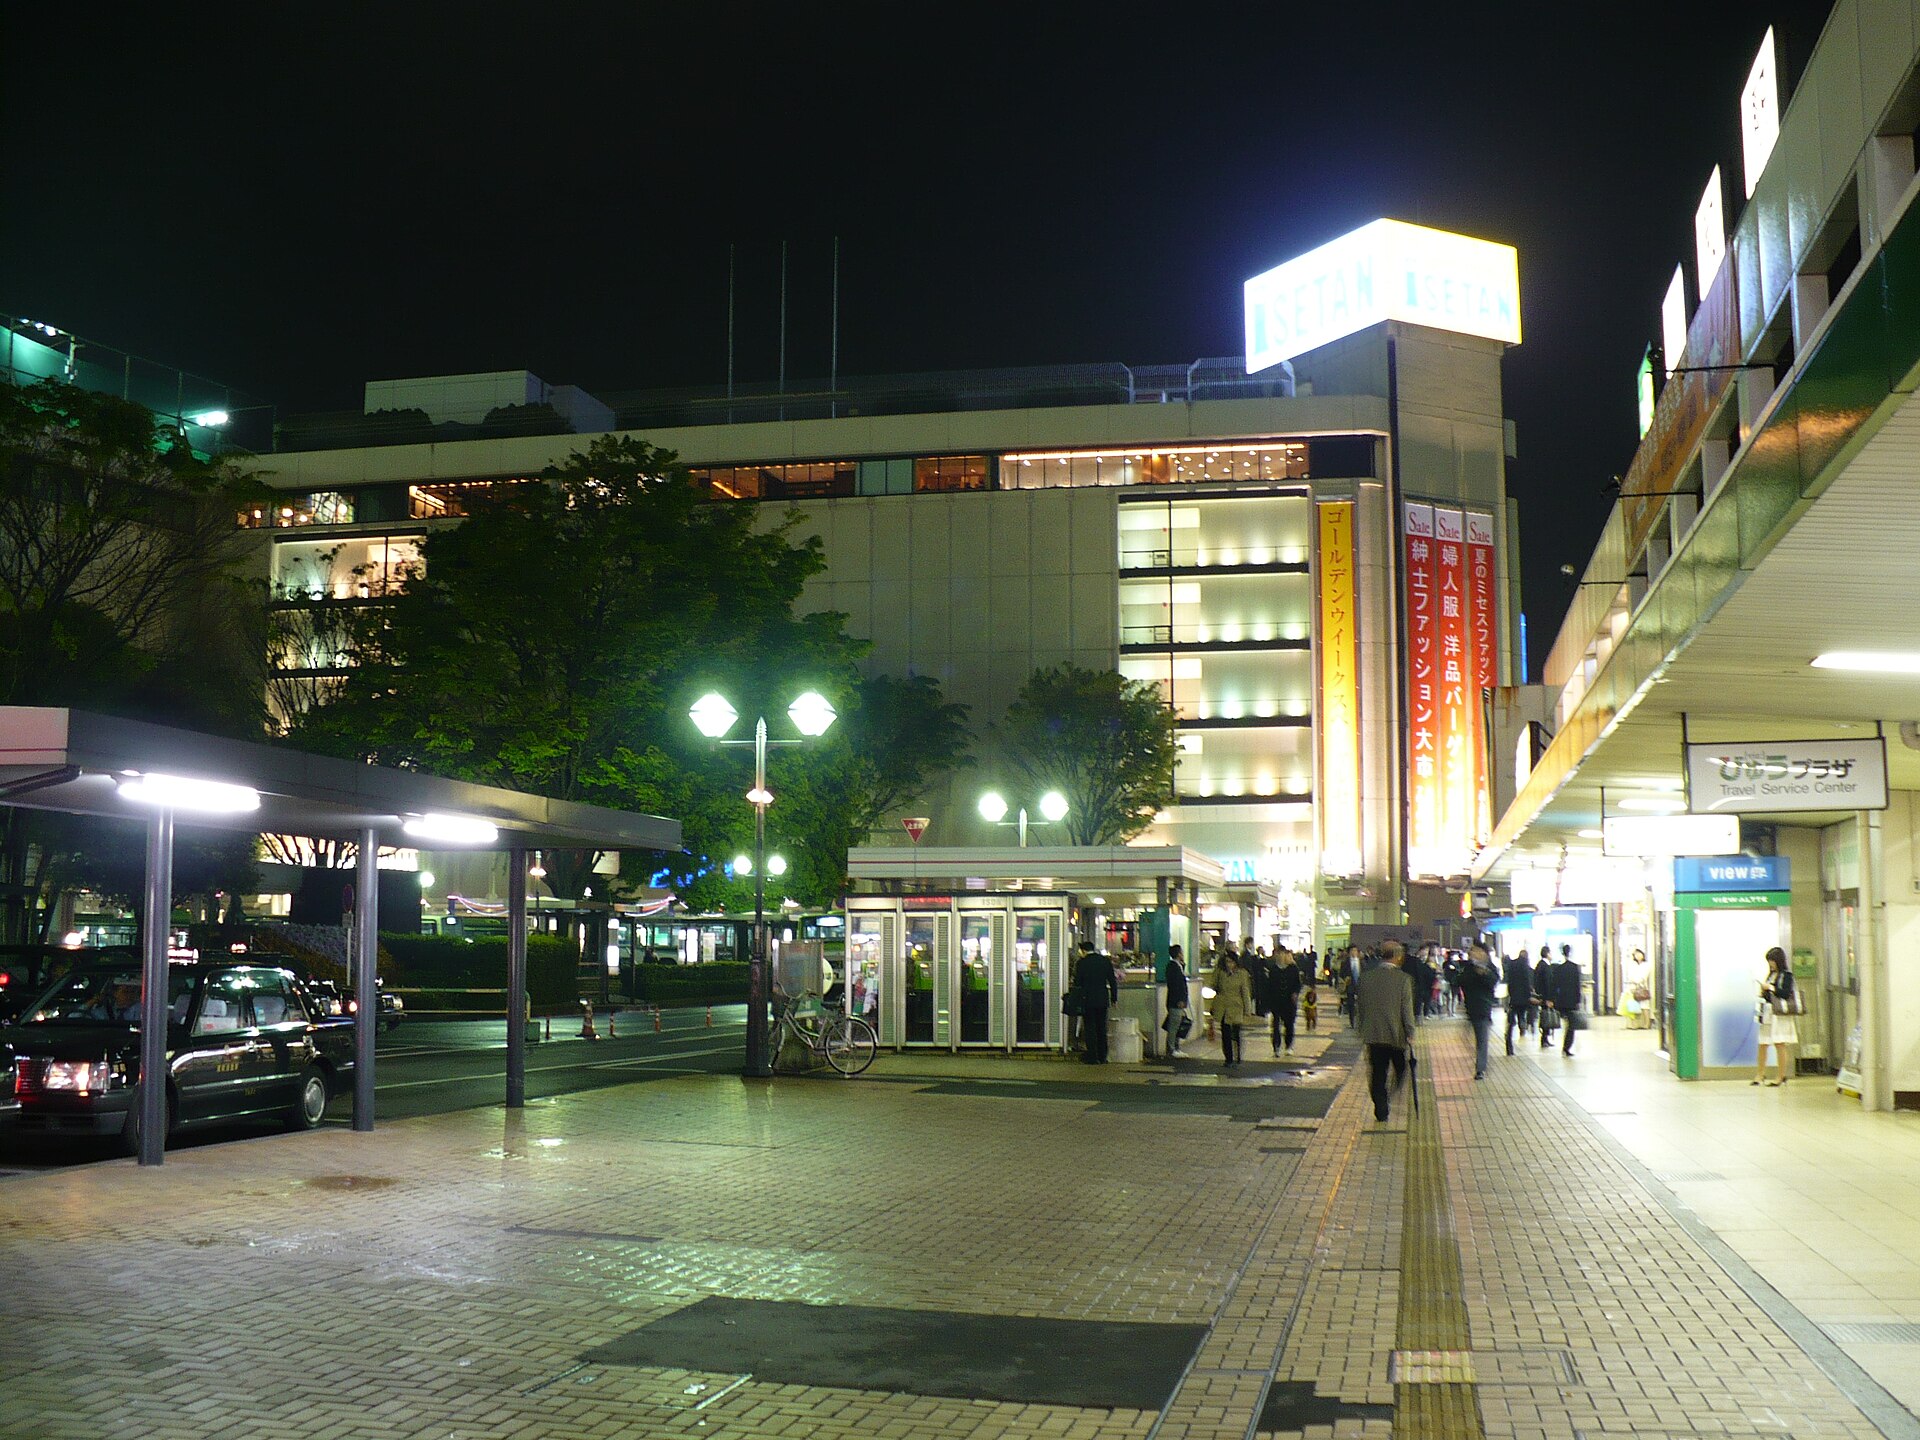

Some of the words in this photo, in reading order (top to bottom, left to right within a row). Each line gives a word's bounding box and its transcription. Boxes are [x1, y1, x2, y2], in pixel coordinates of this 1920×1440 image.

[1253, 255, 1373, 355] ISETAN
[1406, 271, 1511, 325] ISETAN
[1408, 512, 1430, 534] Sale
[1438, 517, 1460, 539] Sale
[1469, 521, 1490, 543] Sale
[1720, 784, 1756, 796] Travel
[1761, 783, 1810, 795] Service
[1814, 781, 1858, 794] Center
